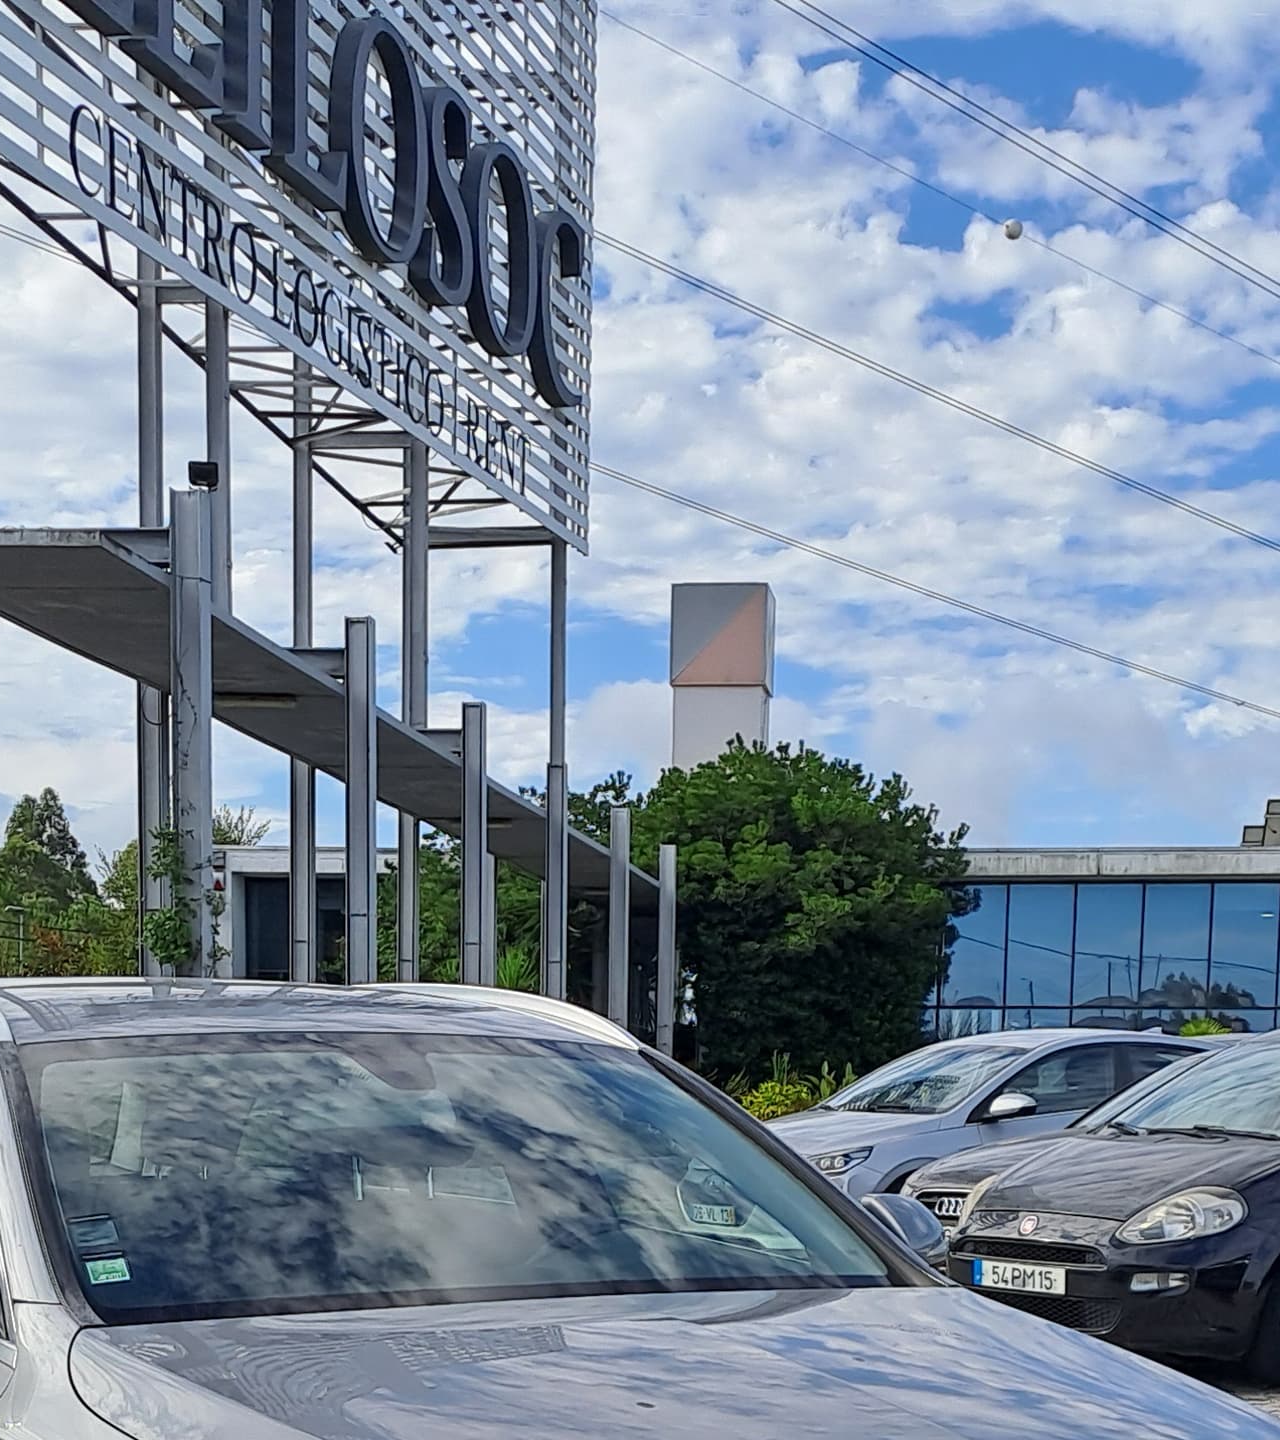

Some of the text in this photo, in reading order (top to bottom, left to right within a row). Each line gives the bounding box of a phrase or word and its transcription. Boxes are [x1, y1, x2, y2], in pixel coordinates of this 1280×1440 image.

[70, 104, 532, 496] CENTRO LOGÍSTICO RENT
